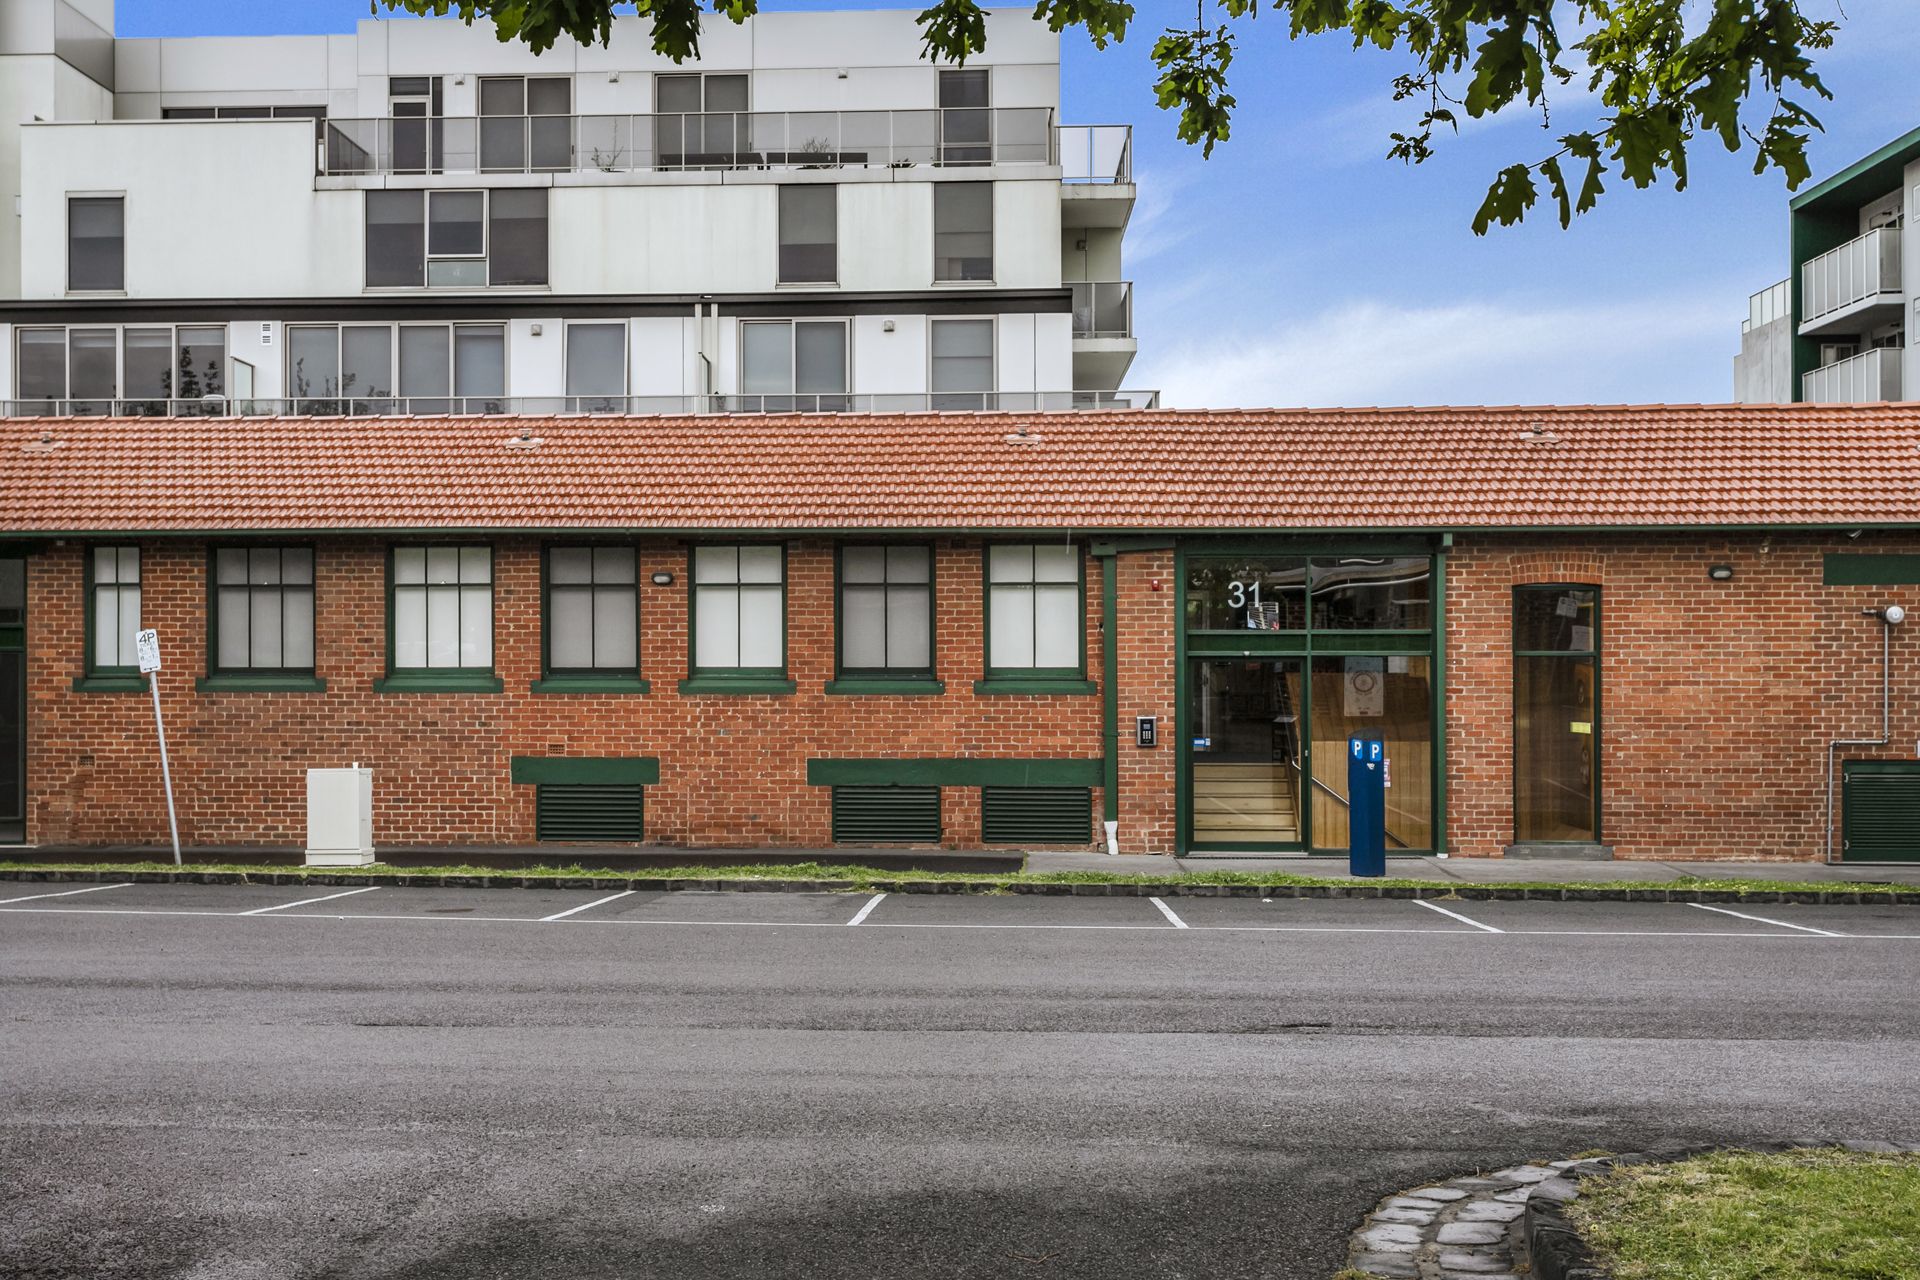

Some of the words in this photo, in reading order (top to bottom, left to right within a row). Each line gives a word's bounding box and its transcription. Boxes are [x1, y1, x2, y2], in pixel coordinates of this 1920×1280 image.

[1227, 581, 1260, 608] 31
[139, 632, 155, 643] 4P
[1354, 741, 1361, 756] P
[1371, 744, 1380, 759] P
